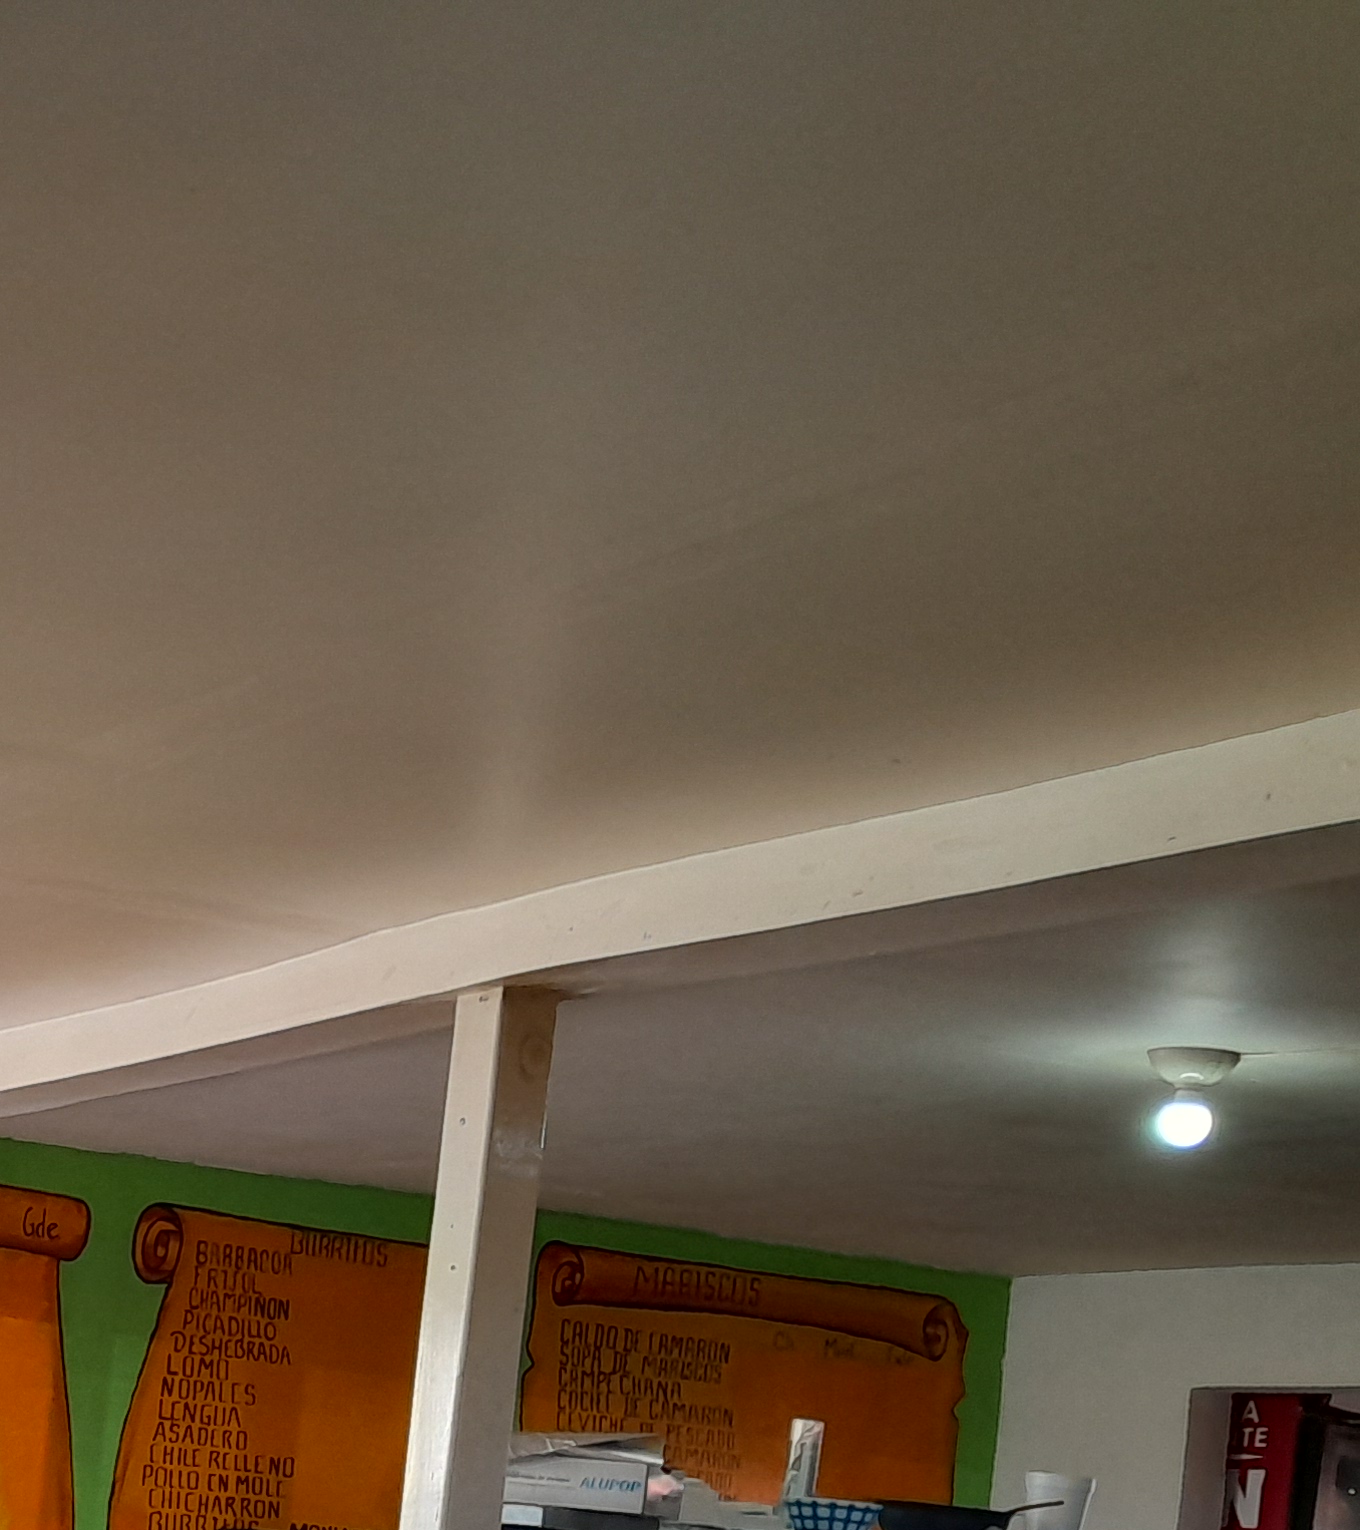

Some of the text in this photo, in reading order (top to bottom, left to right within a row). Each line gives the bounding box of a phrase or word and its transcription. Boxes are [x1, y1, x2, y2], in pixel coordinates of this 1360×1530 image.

[196, 1240, 292, 1276] BARBACOA
[290, 1230, 389, 1267] BURRITOS
[633, 1265, 762, 1307] MARISCOS
[182, 1309, 277, 1341] PICADILLO
[170, 1330, 291, 1365] DESHEBRADA
[559, 1343, 602, 1372] SOPA
[560, 1319, 619, 1350] CALDO
[649, 1332, 731, 1364] CAMARON
[166, 1353, 229, 1380] LOMO
[160, 1376, 257, 1406] NOPALES
[158, 1398, 242, 1428] LENGUA
[649, 1397, 735, 1428] CAMARON
[152, 1421, 248, 1451] ASADERO
[149, 1443, 295, 1479] CHILE RELLENO
[142, 1464, 284, 1499] POLLO EN MOLE
[148, 1488, 281, 1519] CHICHARRON
